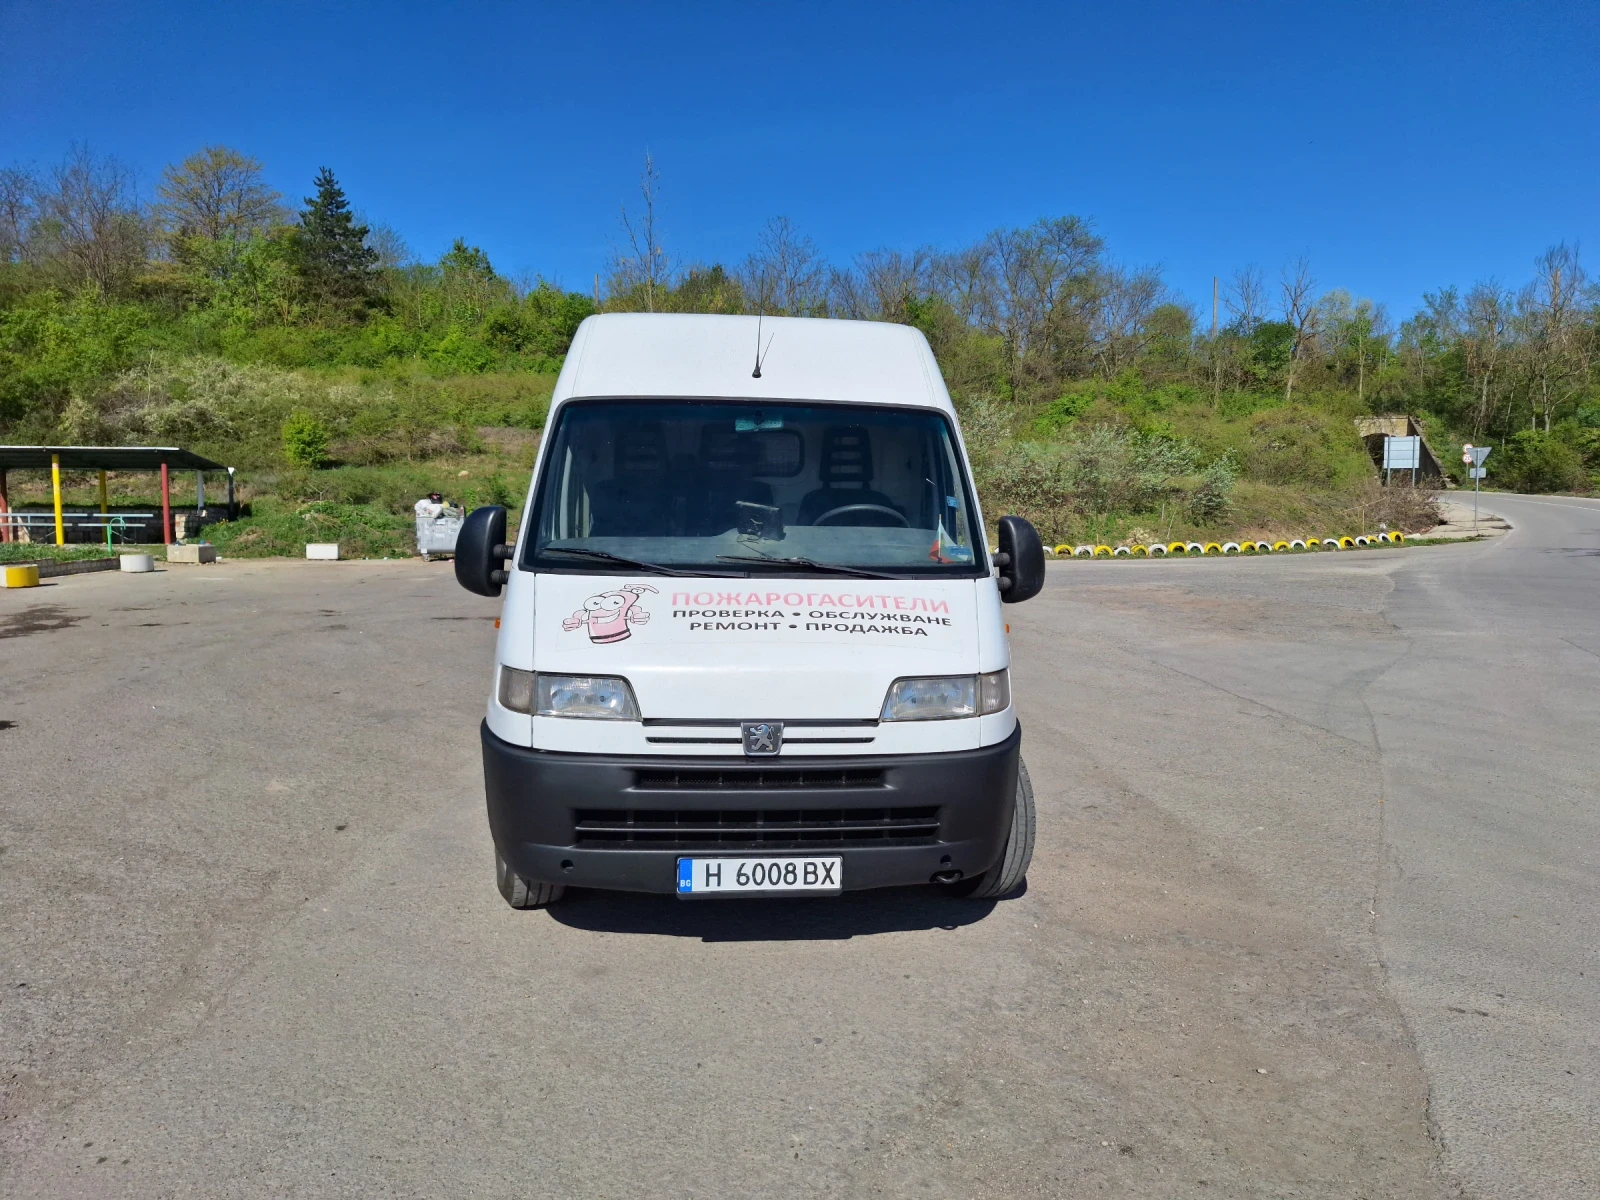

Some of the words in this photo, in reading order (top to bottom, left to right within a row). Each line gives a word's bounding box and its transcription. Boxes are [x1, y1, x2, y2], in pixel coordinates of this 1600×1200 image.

[672, 592, 949, 613] ПОЖАРОГАСИТЕЛИ
[672, 610, 785, 618] ПРОВЕРКА
[808, 611, 952, 626] ОБСЛУЖВАНЕ
[690, 622, 780, 631] РЕМОНТ
[806, 623, 928, 636] ПРОДАЖБА
[680, 879, 691, 887] BG
